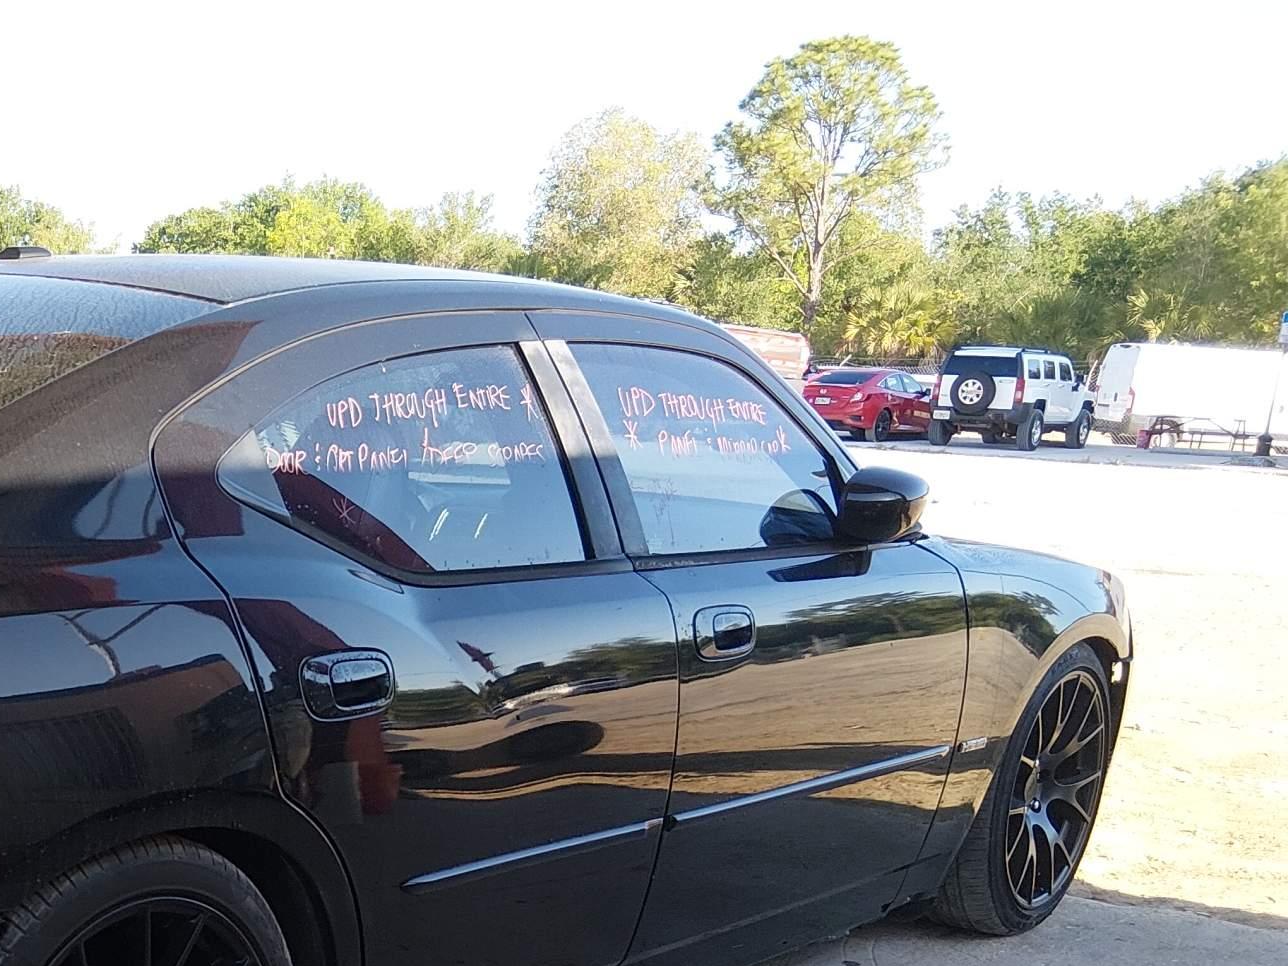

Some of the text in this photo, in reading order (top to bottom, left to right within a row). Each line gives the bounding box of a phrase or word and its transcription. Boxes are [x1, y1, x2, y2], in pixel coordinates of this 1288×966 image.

[327, 398, 362, 429] UPD
[368, 387, 447, 427] THROUGH
[617, 386, 656, 418] UPD
[657, 392, 726, 432] THROUGH
